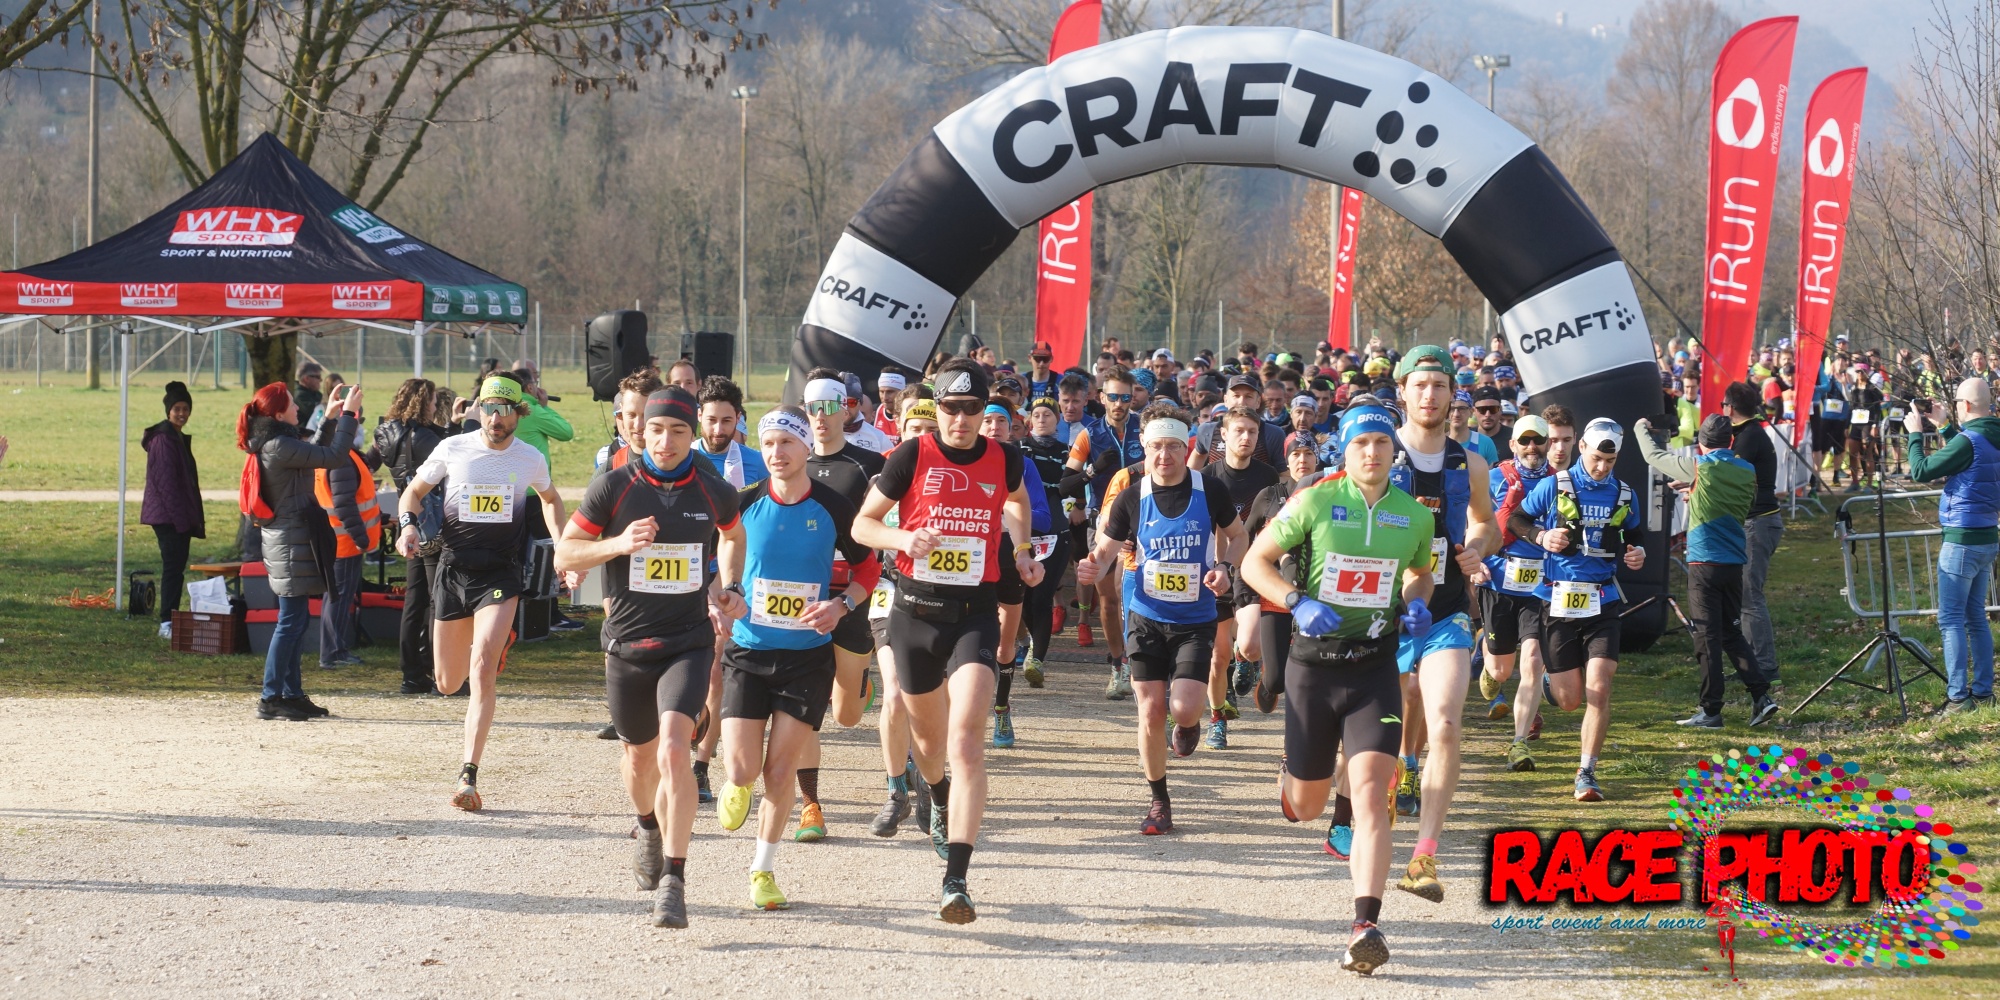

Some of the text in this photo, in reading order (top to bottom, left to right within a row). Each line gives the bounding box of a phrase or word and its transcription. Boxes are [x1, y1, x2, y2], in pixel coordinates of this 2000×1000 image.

[993, 61, 1371, 183] CRAFT
[186, 210, 298, 233] WHY
[197, 233, 269, 242] SPORT
[1709, 176, 1760, 304] iRun
[160, 249, 293, 258] SPORT & NUTRITION
[1804, 199, 1840, 305] iRun
[21, 283, 70, 296] WHY
[124, 284, 173, 296] WHY
[228, 285, 278, 298] WHY
[336, 286, 386, 299] WHY
[820, 275, 910, 319] CRAFT
[1520, 309, 1611, 354] CRAFT
[475, 496, 500, 512] 176
[928, 503, 992, 521] vicenza
[1379, 510, 1409, 521] Vicenza
[926, 517, 990, 534] runners
[1150, 534, 1201, 550] ATLETICA
[930, 551, 968, 572] 285
[1160, 547, 1190, 560] MALO
[650, 559, 681, 580] 211
[1518, 569, 1538, 583] 189
[1159, 574, 1186, 592] 153
[1351, 571, 1366, 593] 2
[767, 595, 804, 617] 209
[1566, 593, 1588, 608] 187
